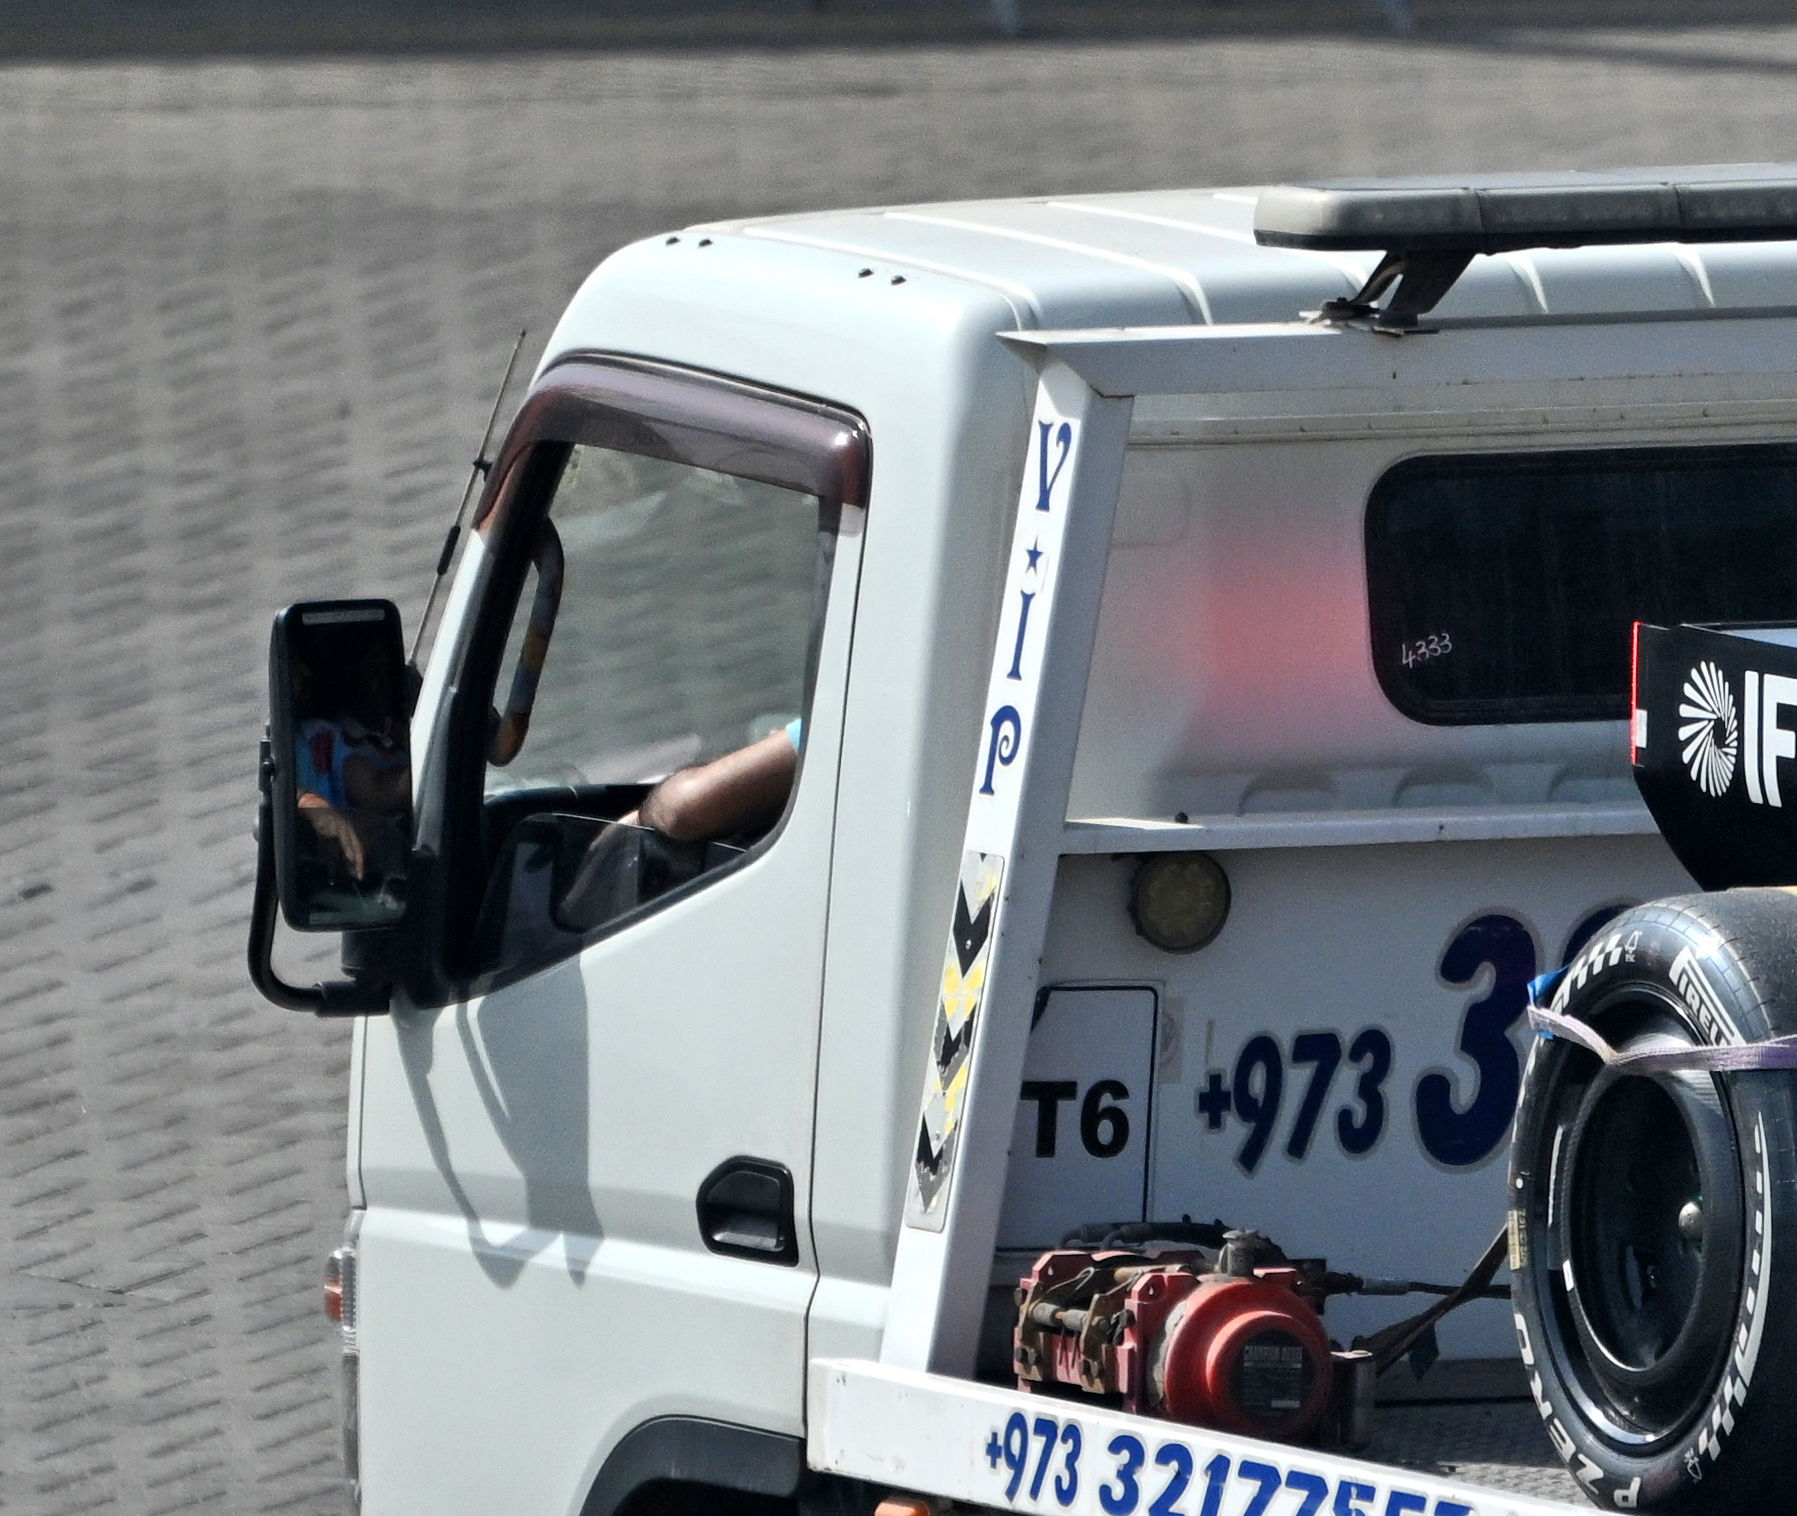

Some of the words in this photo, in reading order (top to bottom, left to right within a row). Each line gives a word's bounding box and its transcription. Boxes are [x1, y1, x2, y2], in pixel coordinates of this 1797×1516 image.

[1401, 632, 1453, 669] 4333
[1198, 1028, 1392, 1174] +973
[985, 1411, 1083, 1506] +973
[1513, 1313, 1604, 1496] ZERO
